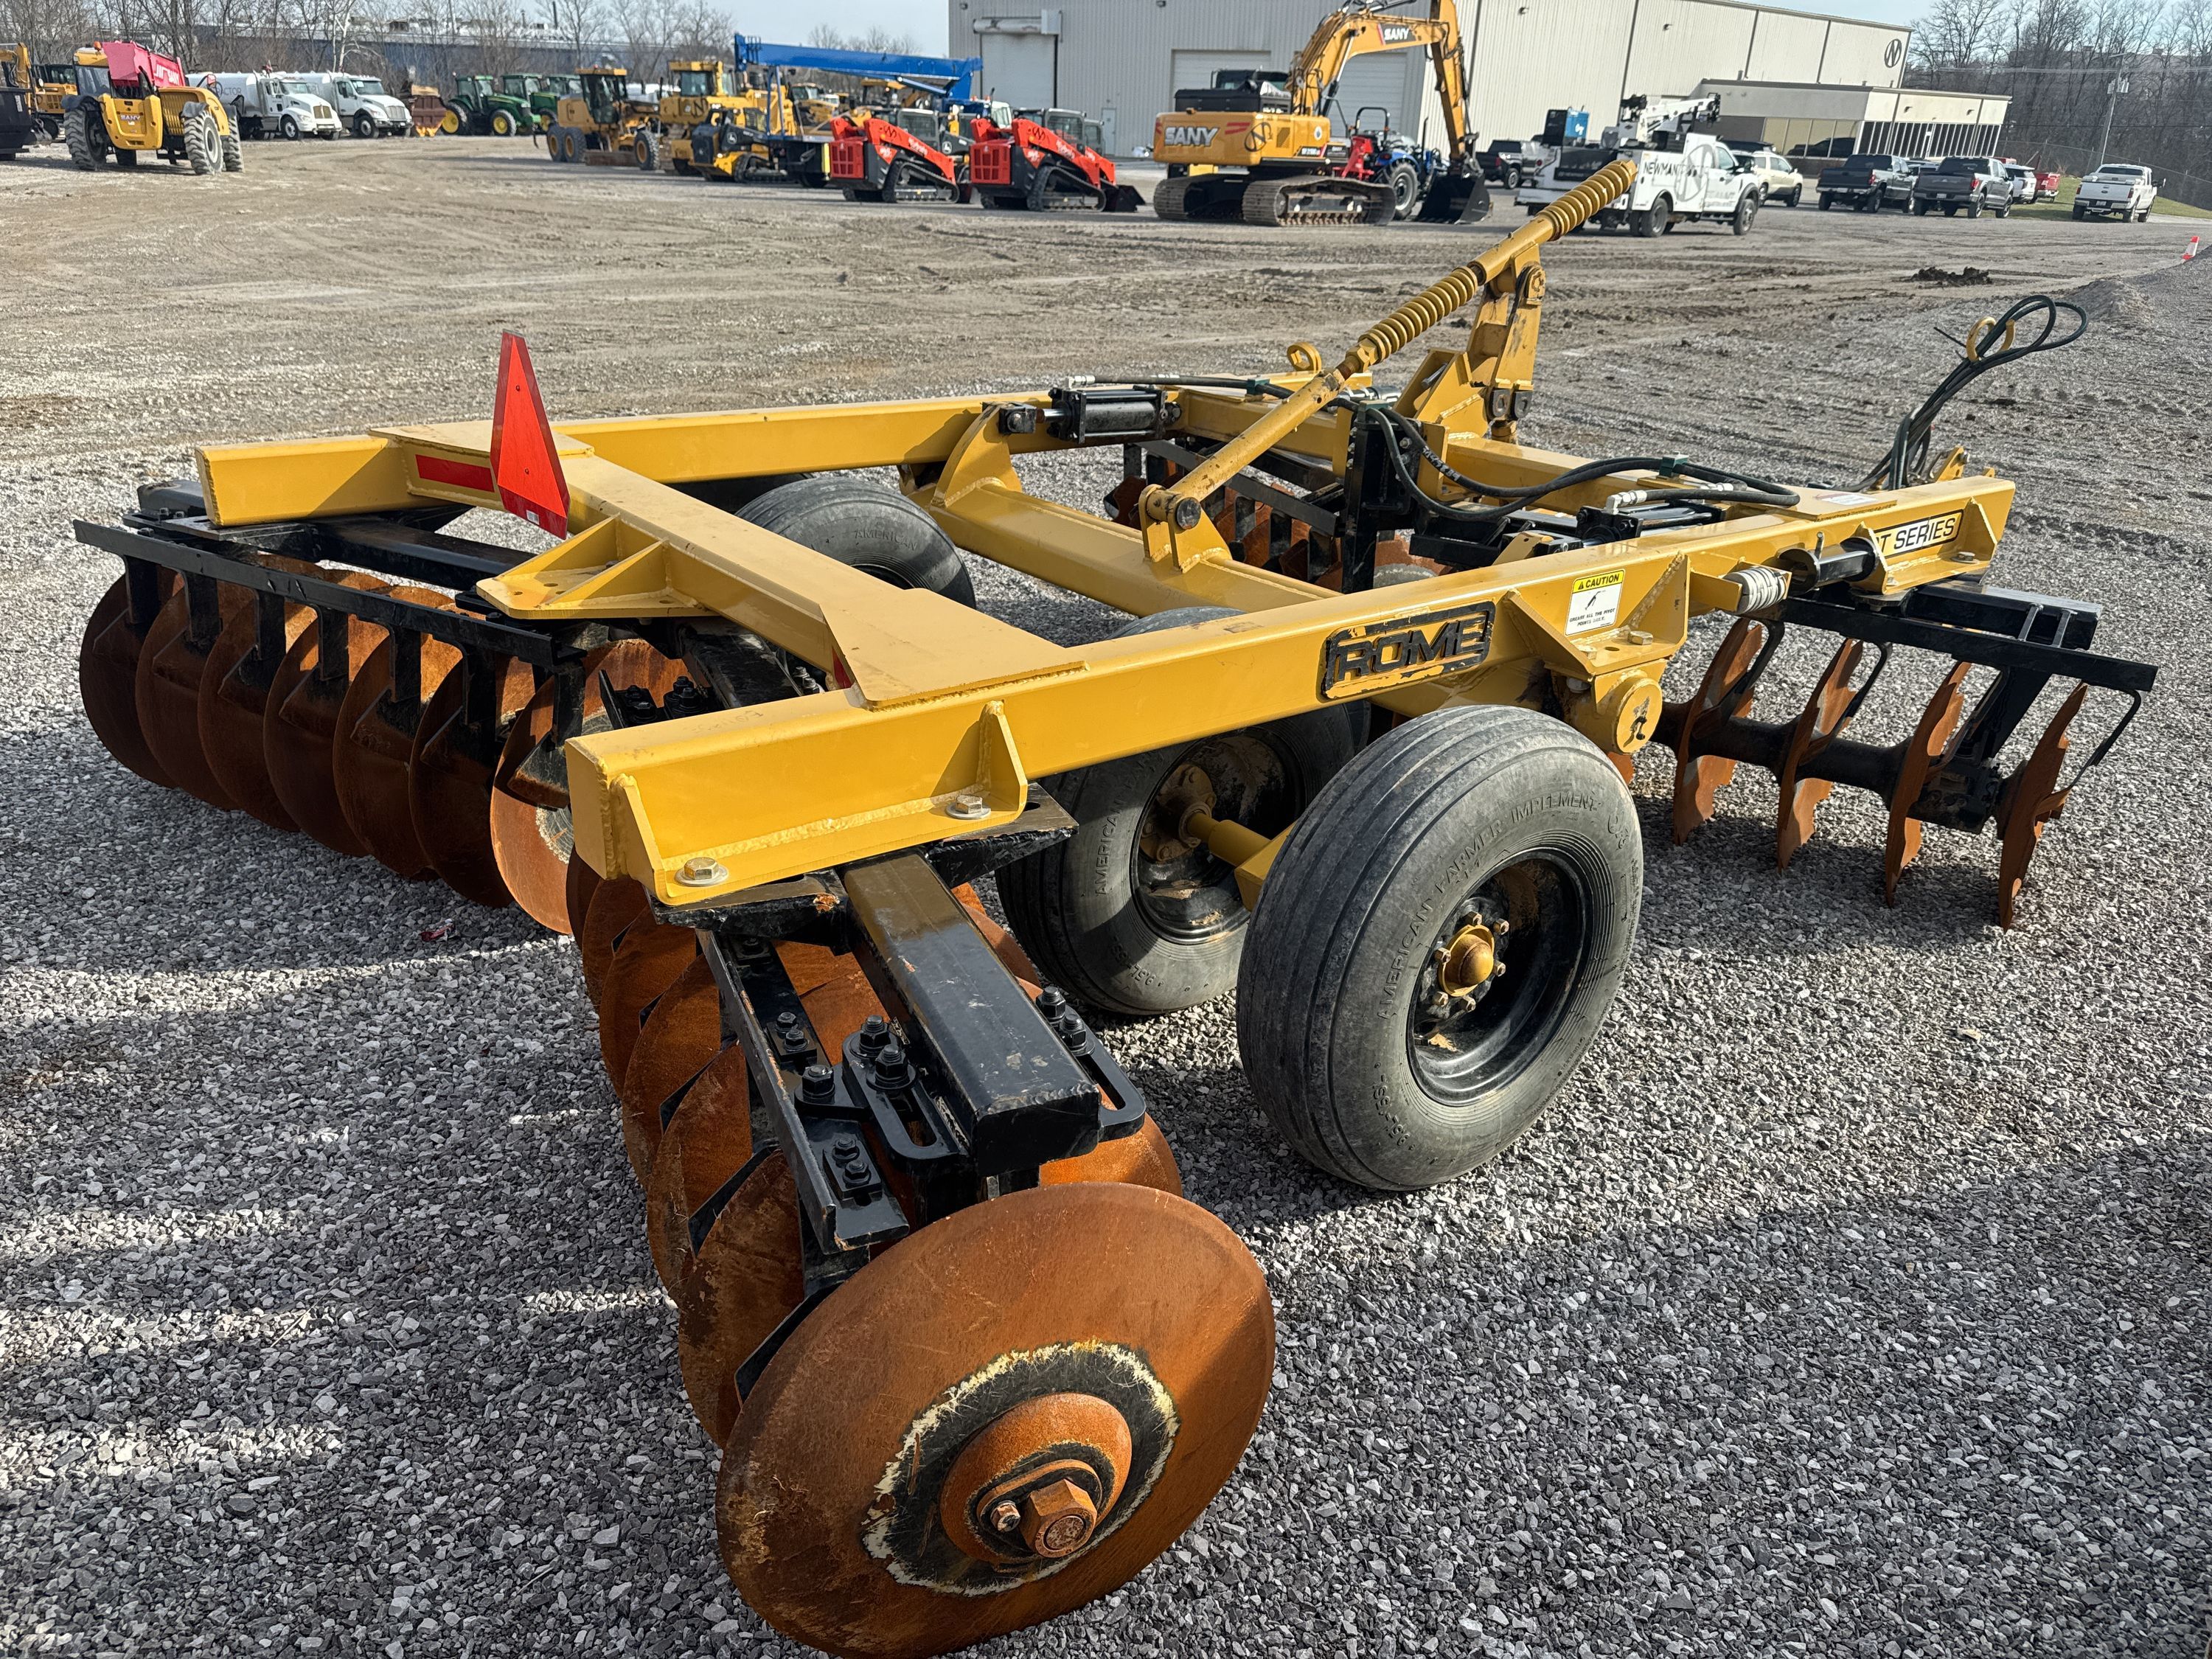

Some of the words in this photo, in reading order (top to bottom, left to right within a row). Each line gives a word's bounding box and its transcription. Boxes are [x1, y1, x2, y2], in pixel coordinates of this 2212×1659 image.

[1384, 28, 1409, 40] SANY
[1165, 126, 1219, 147] SANY
[855, 529, 918, 551] AMERICAN
[1893, 517, 1955, 550] SERIES
[1585, 574, 1620, 588] CAUTION
[1336, 612, 1486, 681] ROME
[1095, 797, 1124, 896] AMERICAN
[1377, 897, 1433, 1020] AMERICAN
[1435, 819, 1503, 894] FARMER
[1511, 790, 1598, 824] IMPLEMENT
